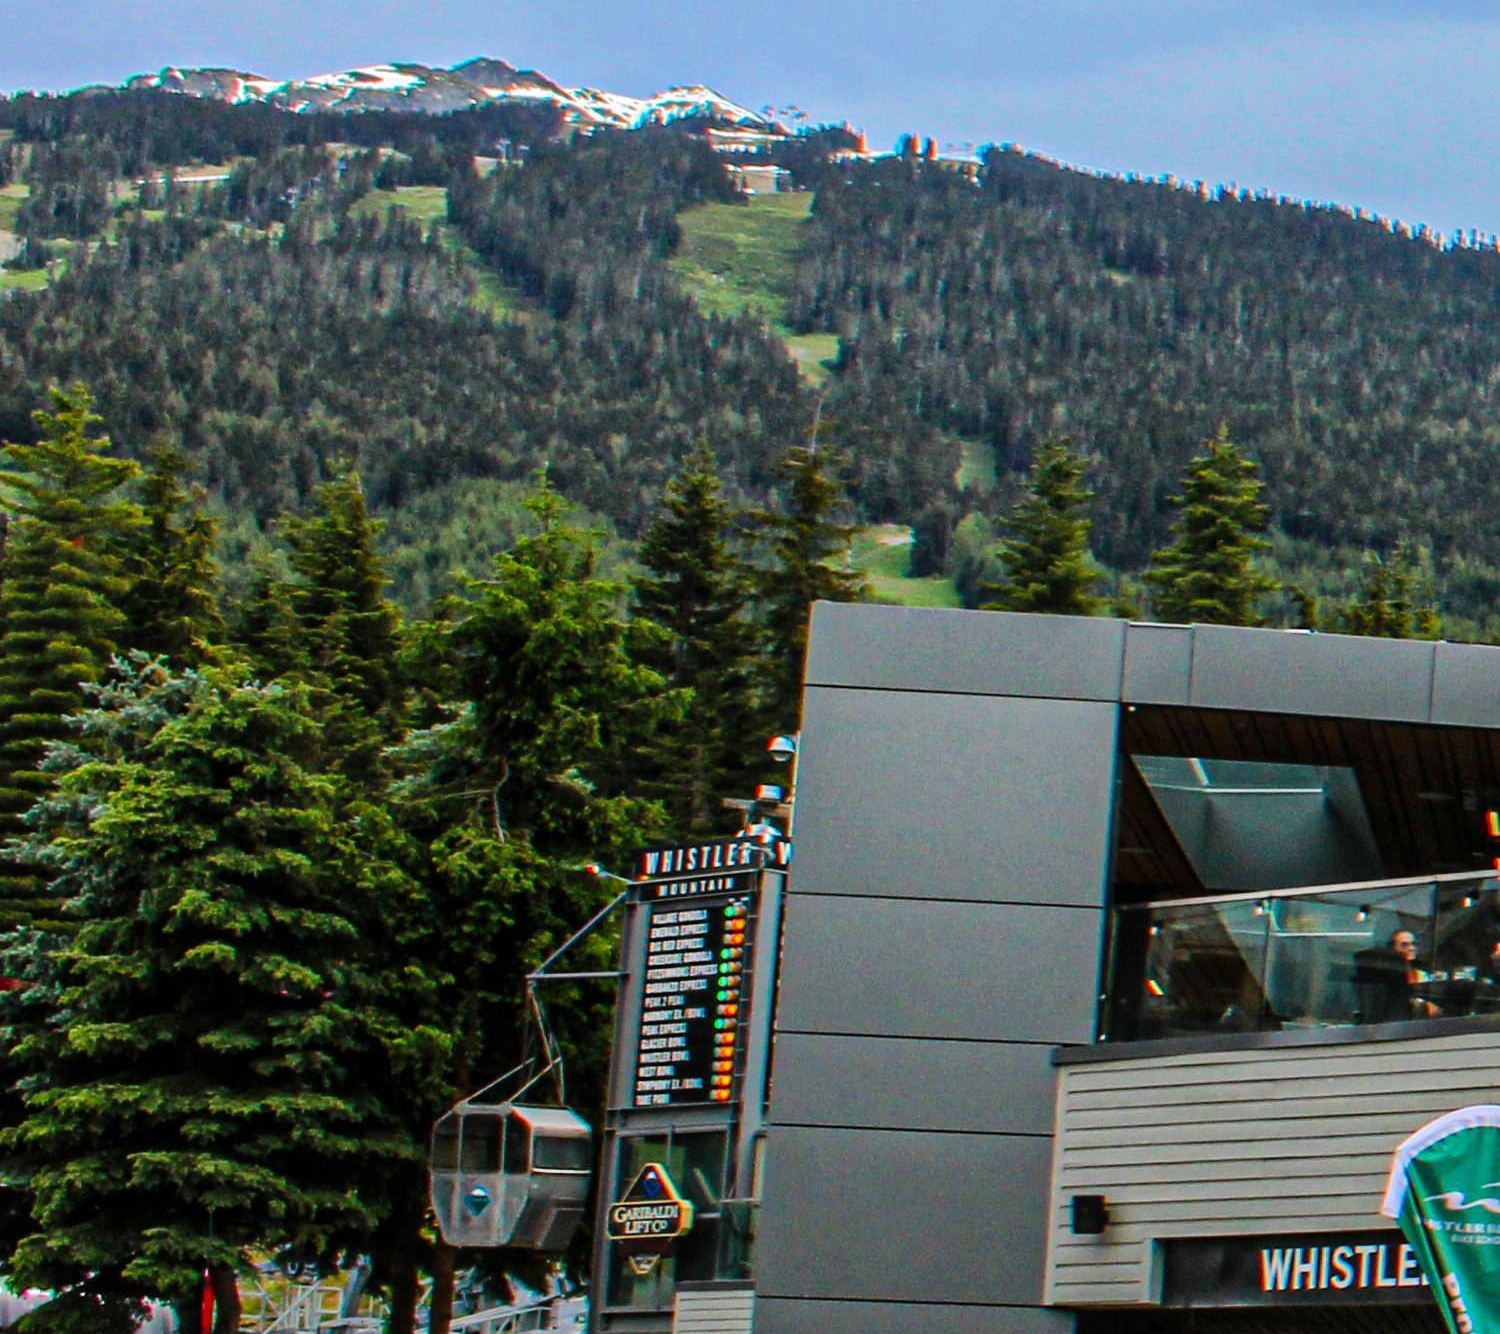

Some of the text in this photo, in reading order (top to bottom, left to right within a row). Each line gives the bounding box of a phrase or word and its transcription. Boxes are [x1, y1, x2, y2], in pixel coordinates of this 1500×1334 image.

[643, 842, 752, 874] WHISTLER
[656, 877, 734, 897] MOUNTAIN
[614, 1205, 679, 1223] GARIBALDI
[624, 1220, 652, 1234] LIFT
[1260, 1243, 1430, 1292] WHISTLE
